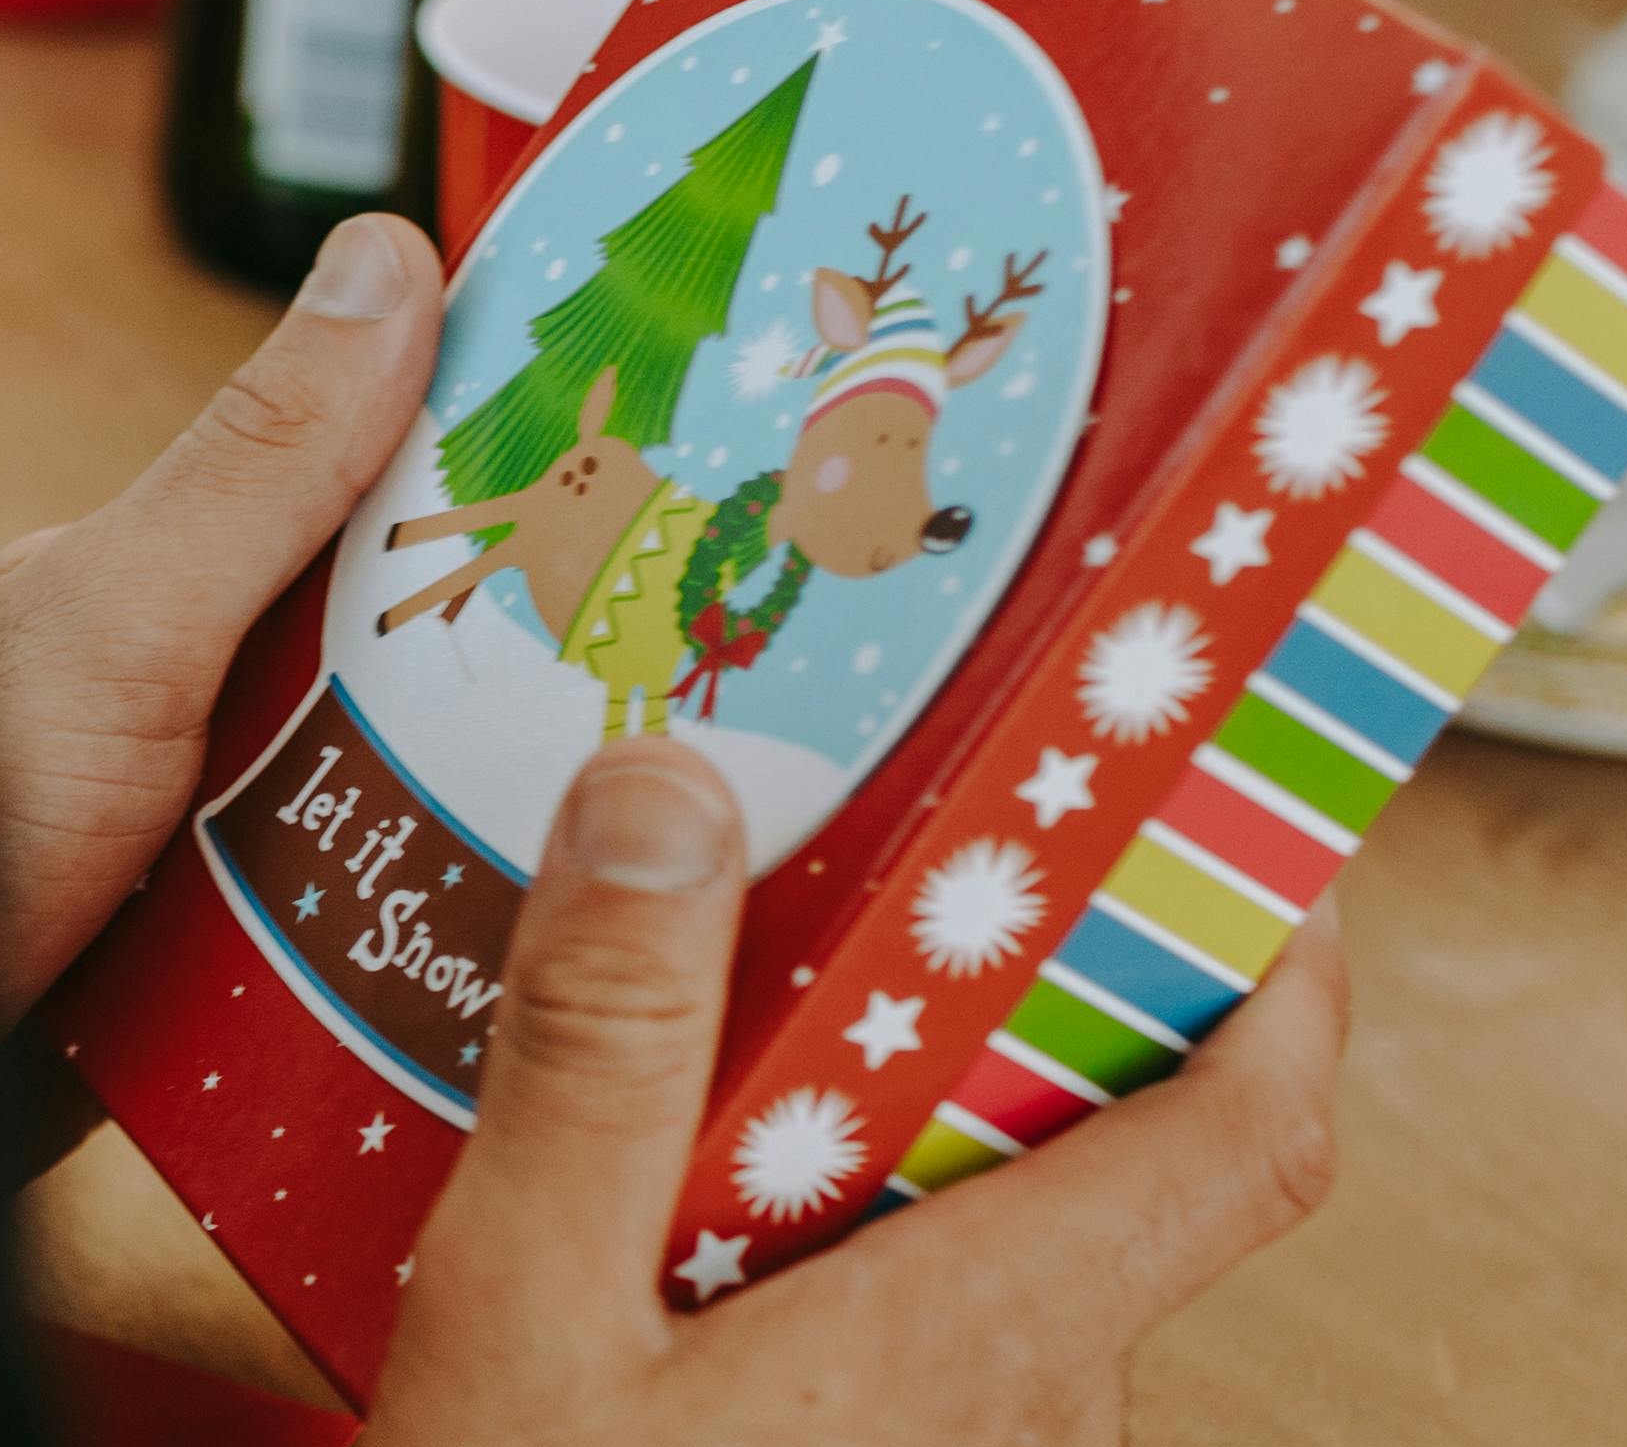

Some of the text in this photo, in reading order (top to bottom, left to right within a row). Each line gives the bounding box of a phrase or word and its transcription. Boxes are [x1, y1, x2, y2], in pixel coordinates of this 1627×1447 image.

[275, 745, 505, 1036] let it Snow
